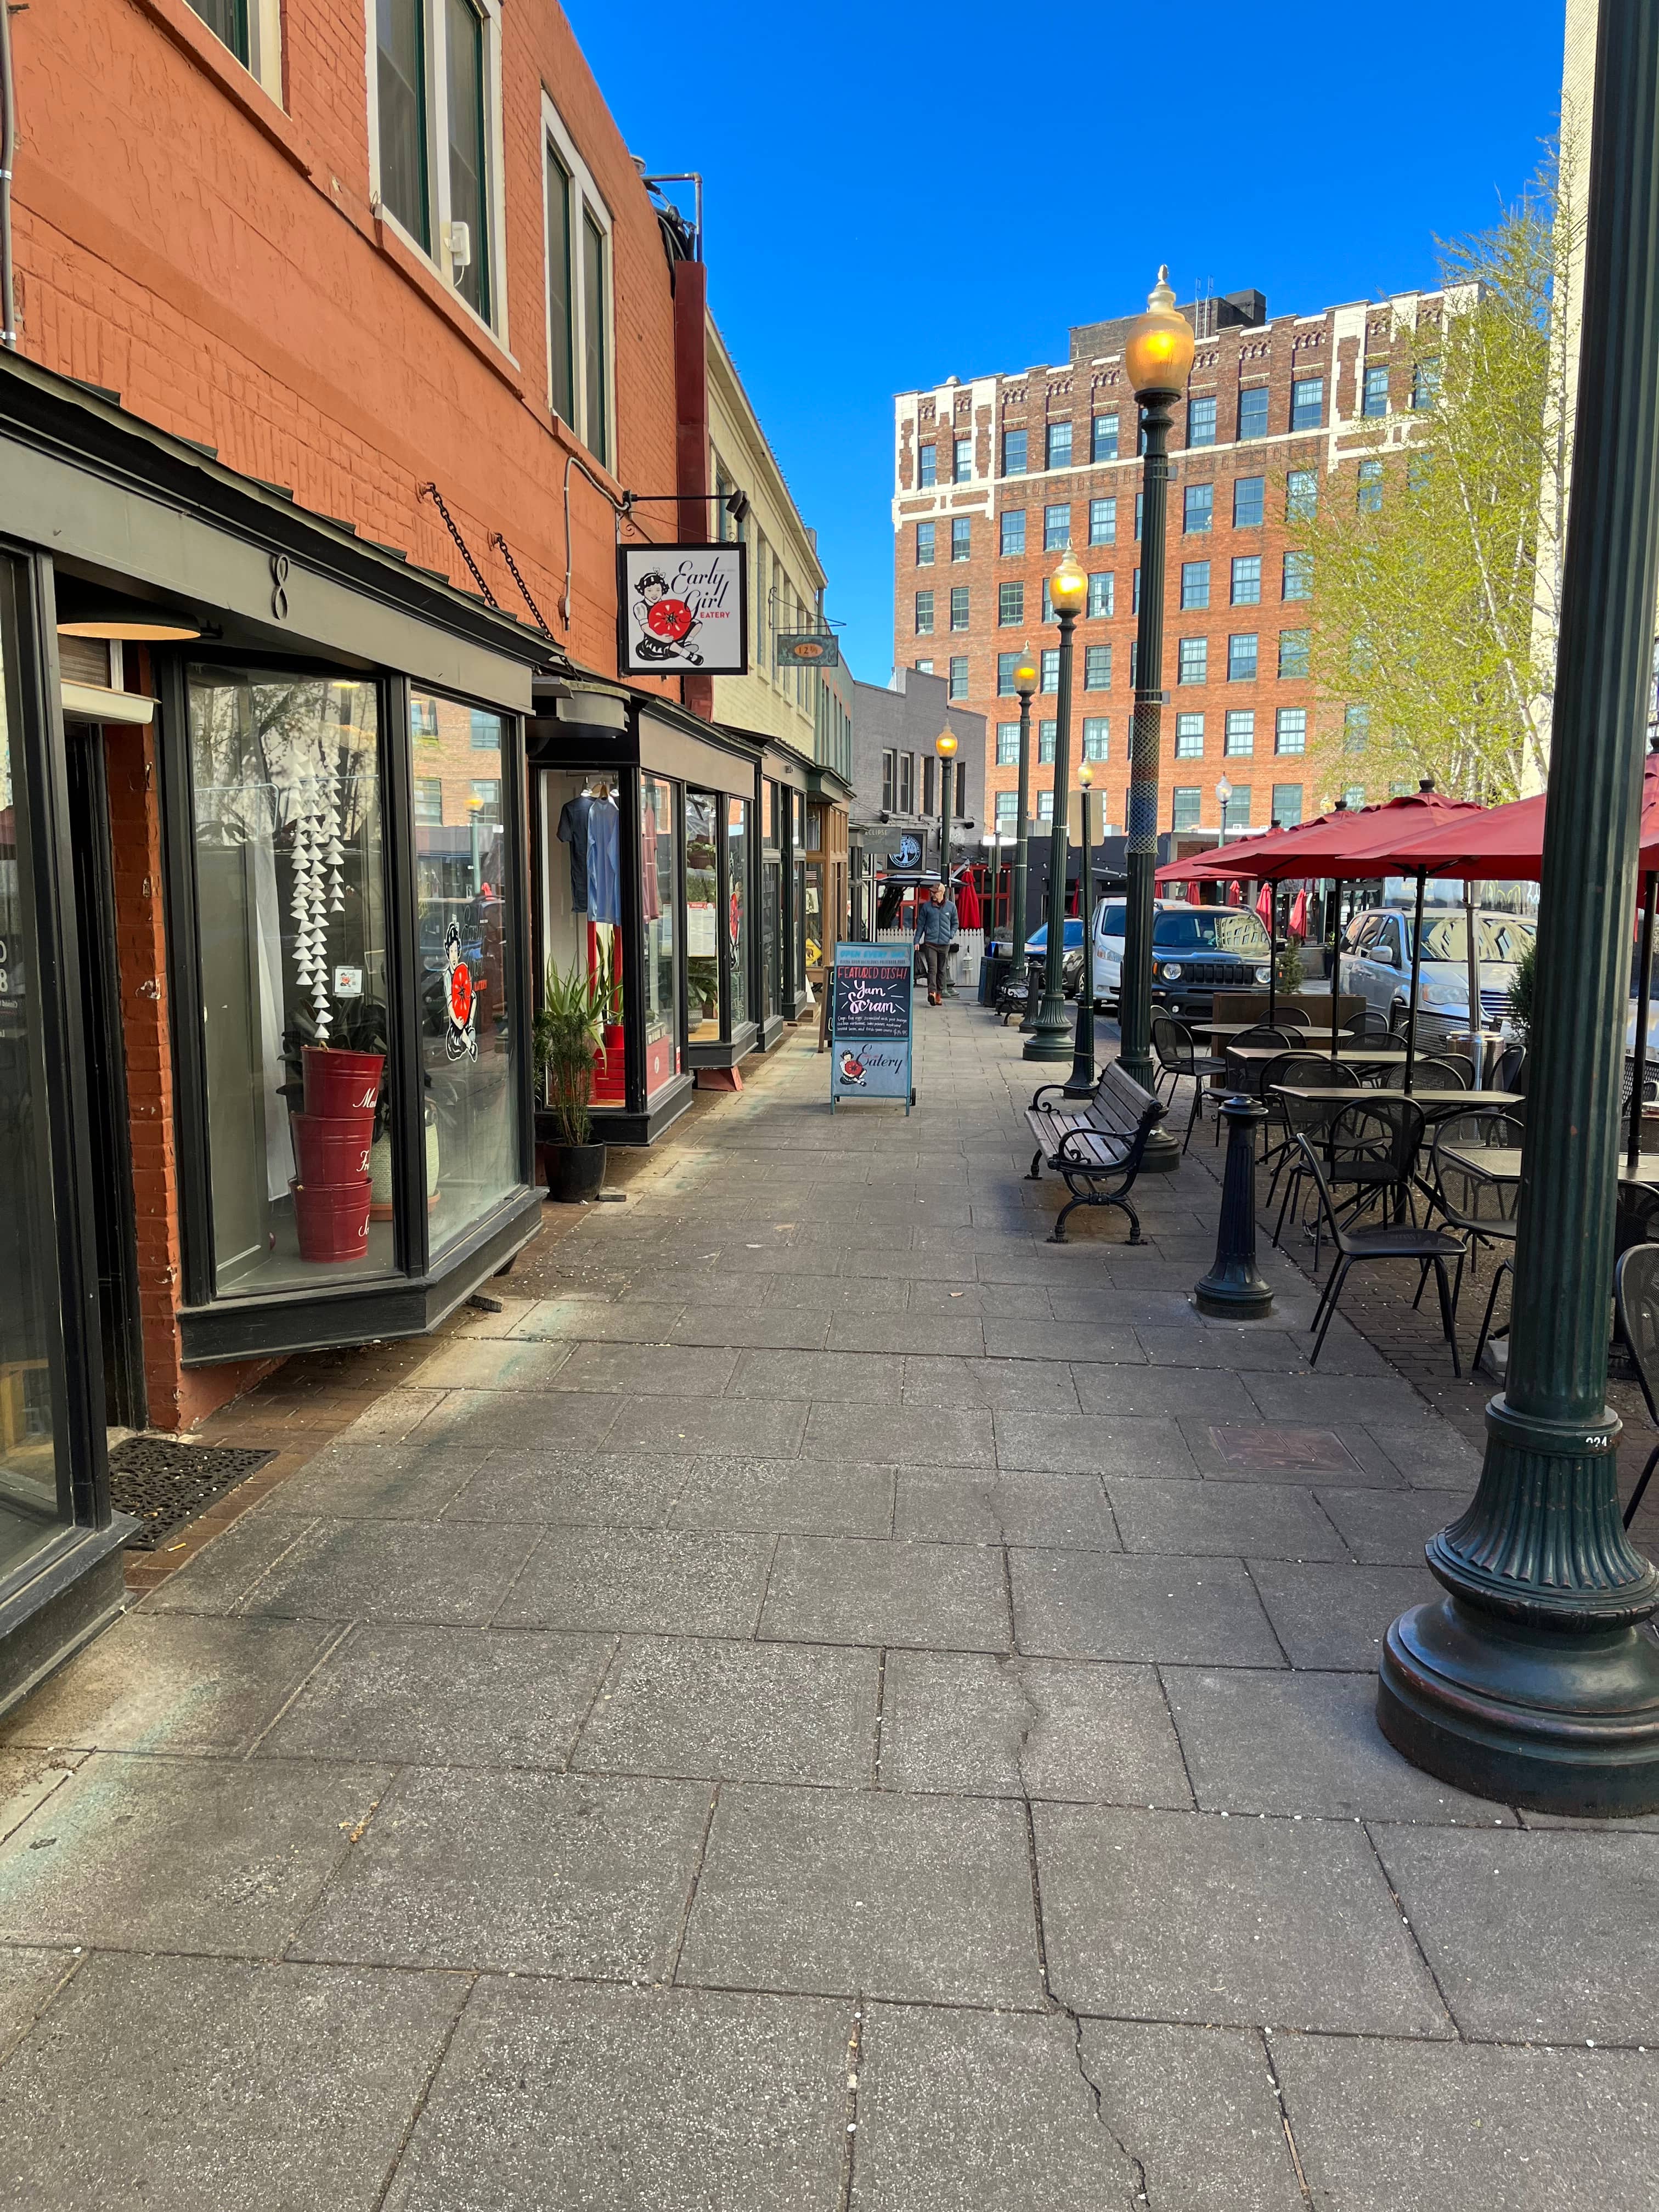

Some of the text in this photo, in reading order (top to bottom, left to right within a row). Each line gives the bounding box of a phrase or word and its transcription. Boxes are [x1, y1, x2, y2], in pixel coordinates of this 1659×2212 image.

[271, 553, 290, 620] 8
[671, 557, 724, 596] Early
[679, 580, 730, 623] Girl
[838, 967, 907, 979] FEATURED DISH!
[848, 991, 896, 1014] Scram
[854, 980, 886, 999] Yam
[856, 1043, 903, 1074] Eatery
